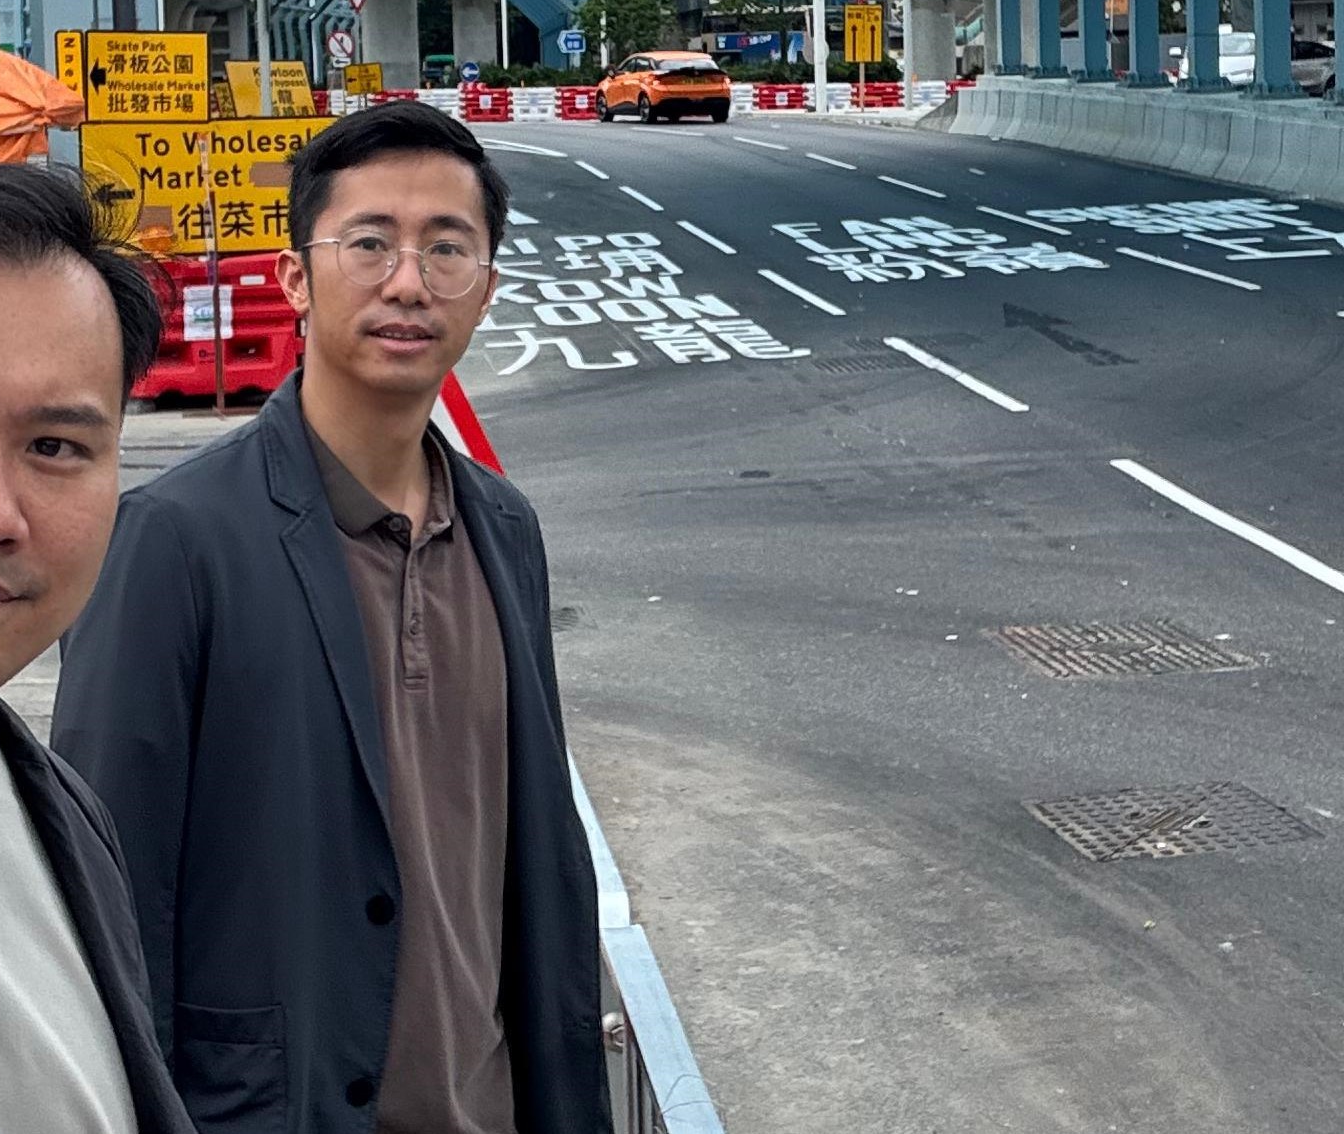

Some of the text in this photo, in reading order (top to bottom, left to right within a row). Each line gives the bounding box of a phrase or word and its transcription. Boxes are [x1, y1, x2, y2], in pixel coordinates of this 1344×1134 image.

[107, 40, 167, 52] Skate Park
[106, 54, 194, 75] 滑板公園
[252, 67, 303, 78] Kwloon
[107, 80, 206, 92] Wholesale Market
[107, 93, 194, 114] 批發市場
[135, 128, 312, 157] To Wholesal
[140, 163, 243, 190] Market
[771, 216, 954, 240] FAN
[554, 232, 662, 252] PO
[795, 228, 1008, 254] LING
[490, 276, 681, 305] KOW
[476, 294, 740, 332] LOON
[485, 318, 812, 376] 九龍
